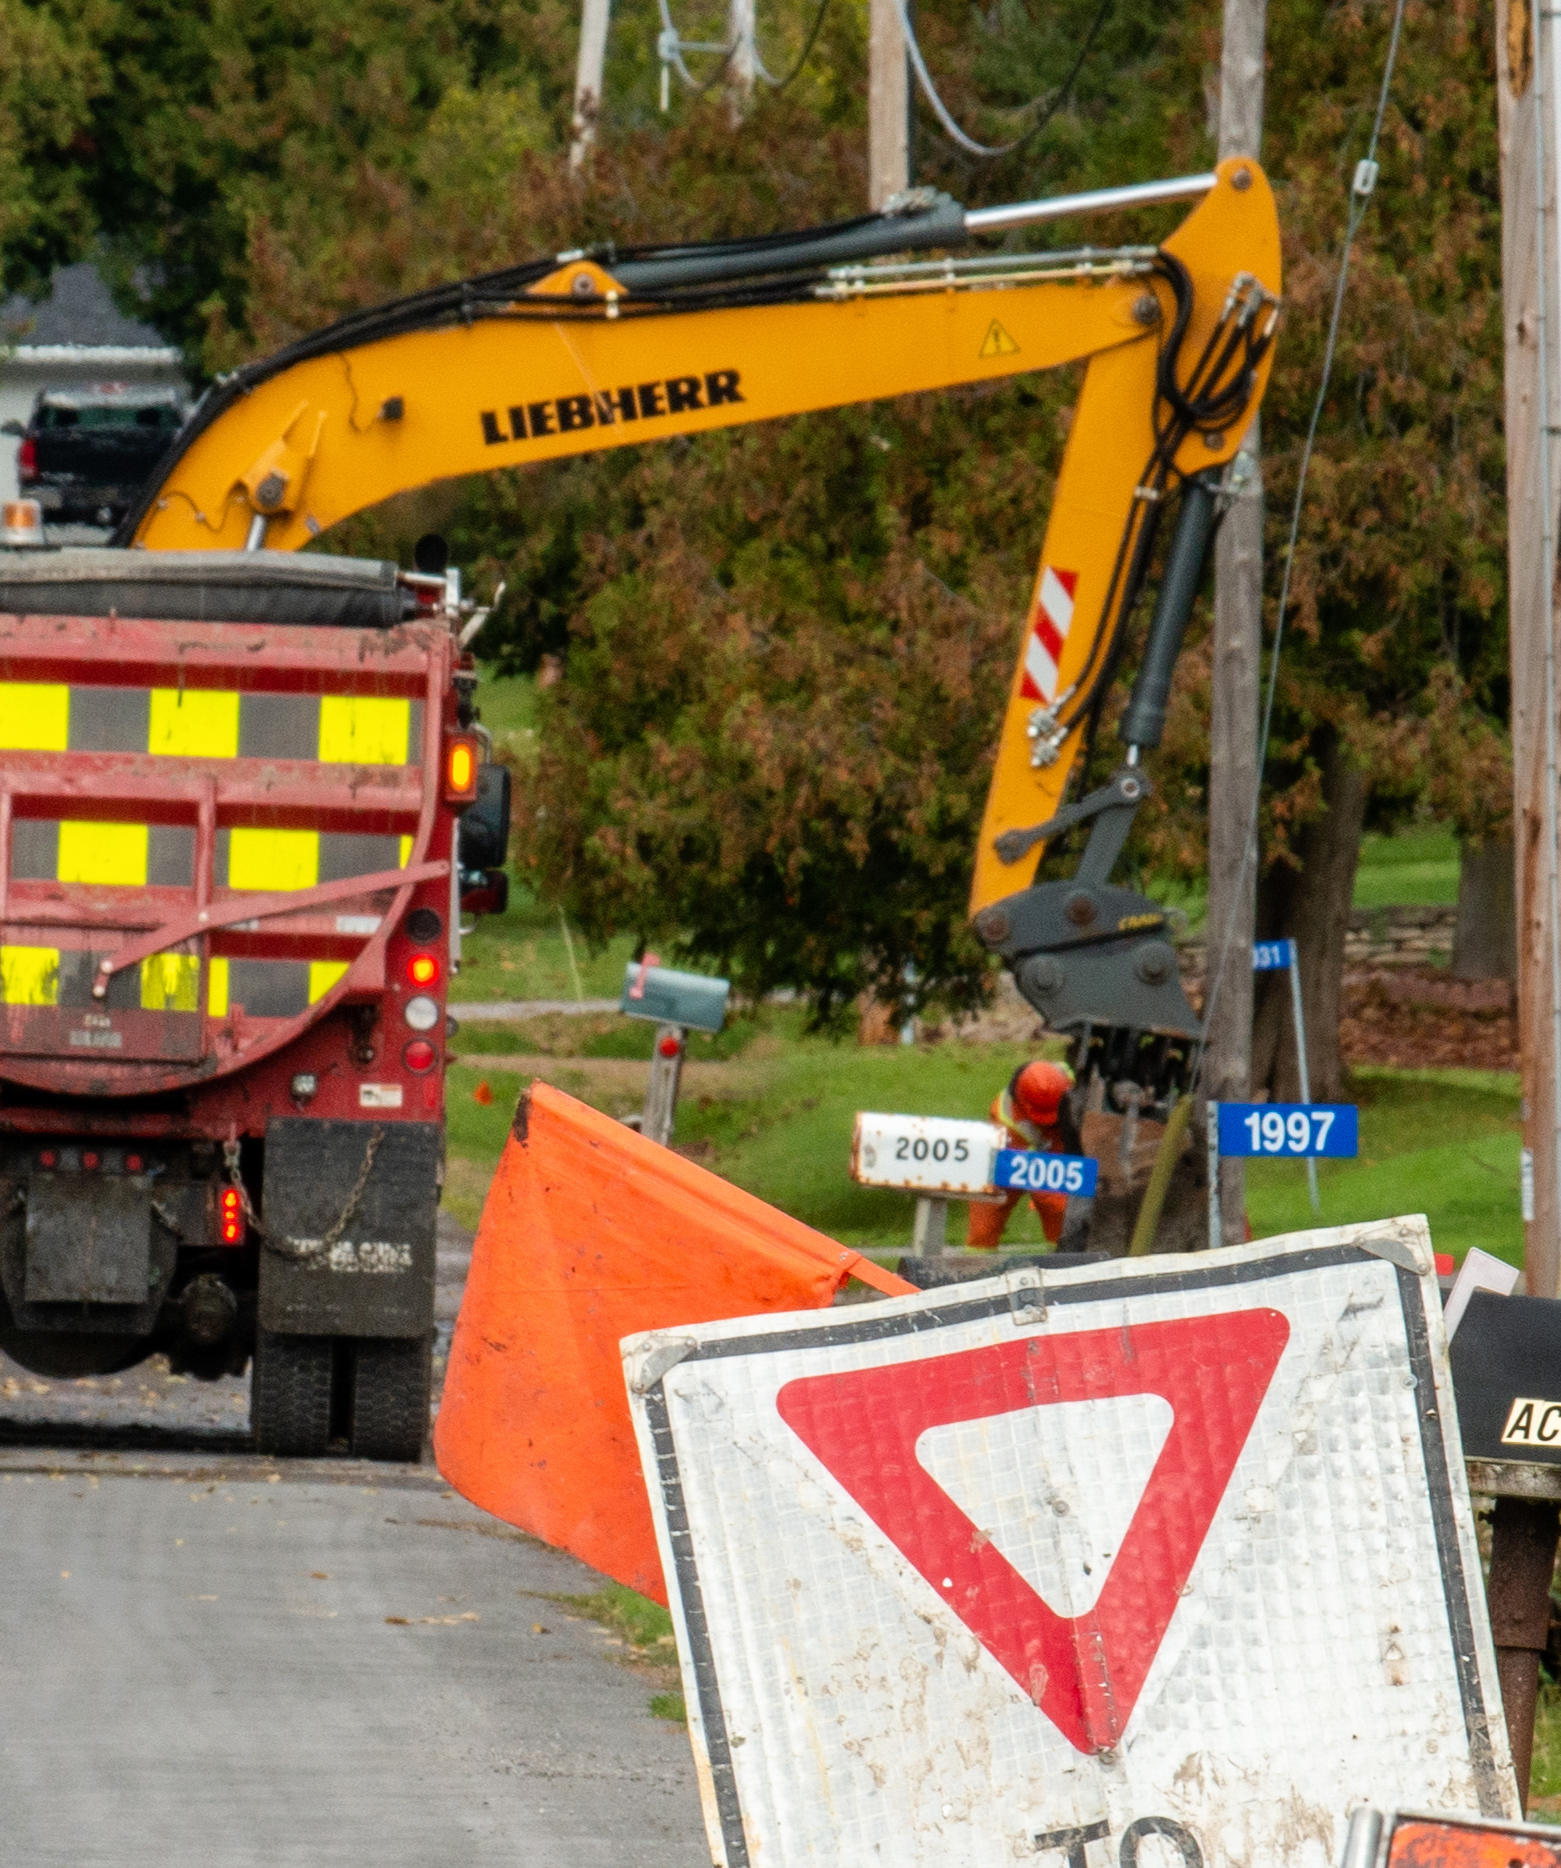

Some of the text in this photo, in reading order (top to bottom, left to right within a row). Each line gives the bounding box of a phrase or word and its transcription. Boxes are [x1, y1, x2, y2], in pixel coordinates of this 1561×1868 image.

[480, 367, 746, 446] LIEBHERR
[895, 1136, 970, 1163] 2005
[1244, 1111, 1337, 1153] 1997
[1008, 1156, 1084, 1191] 2005
